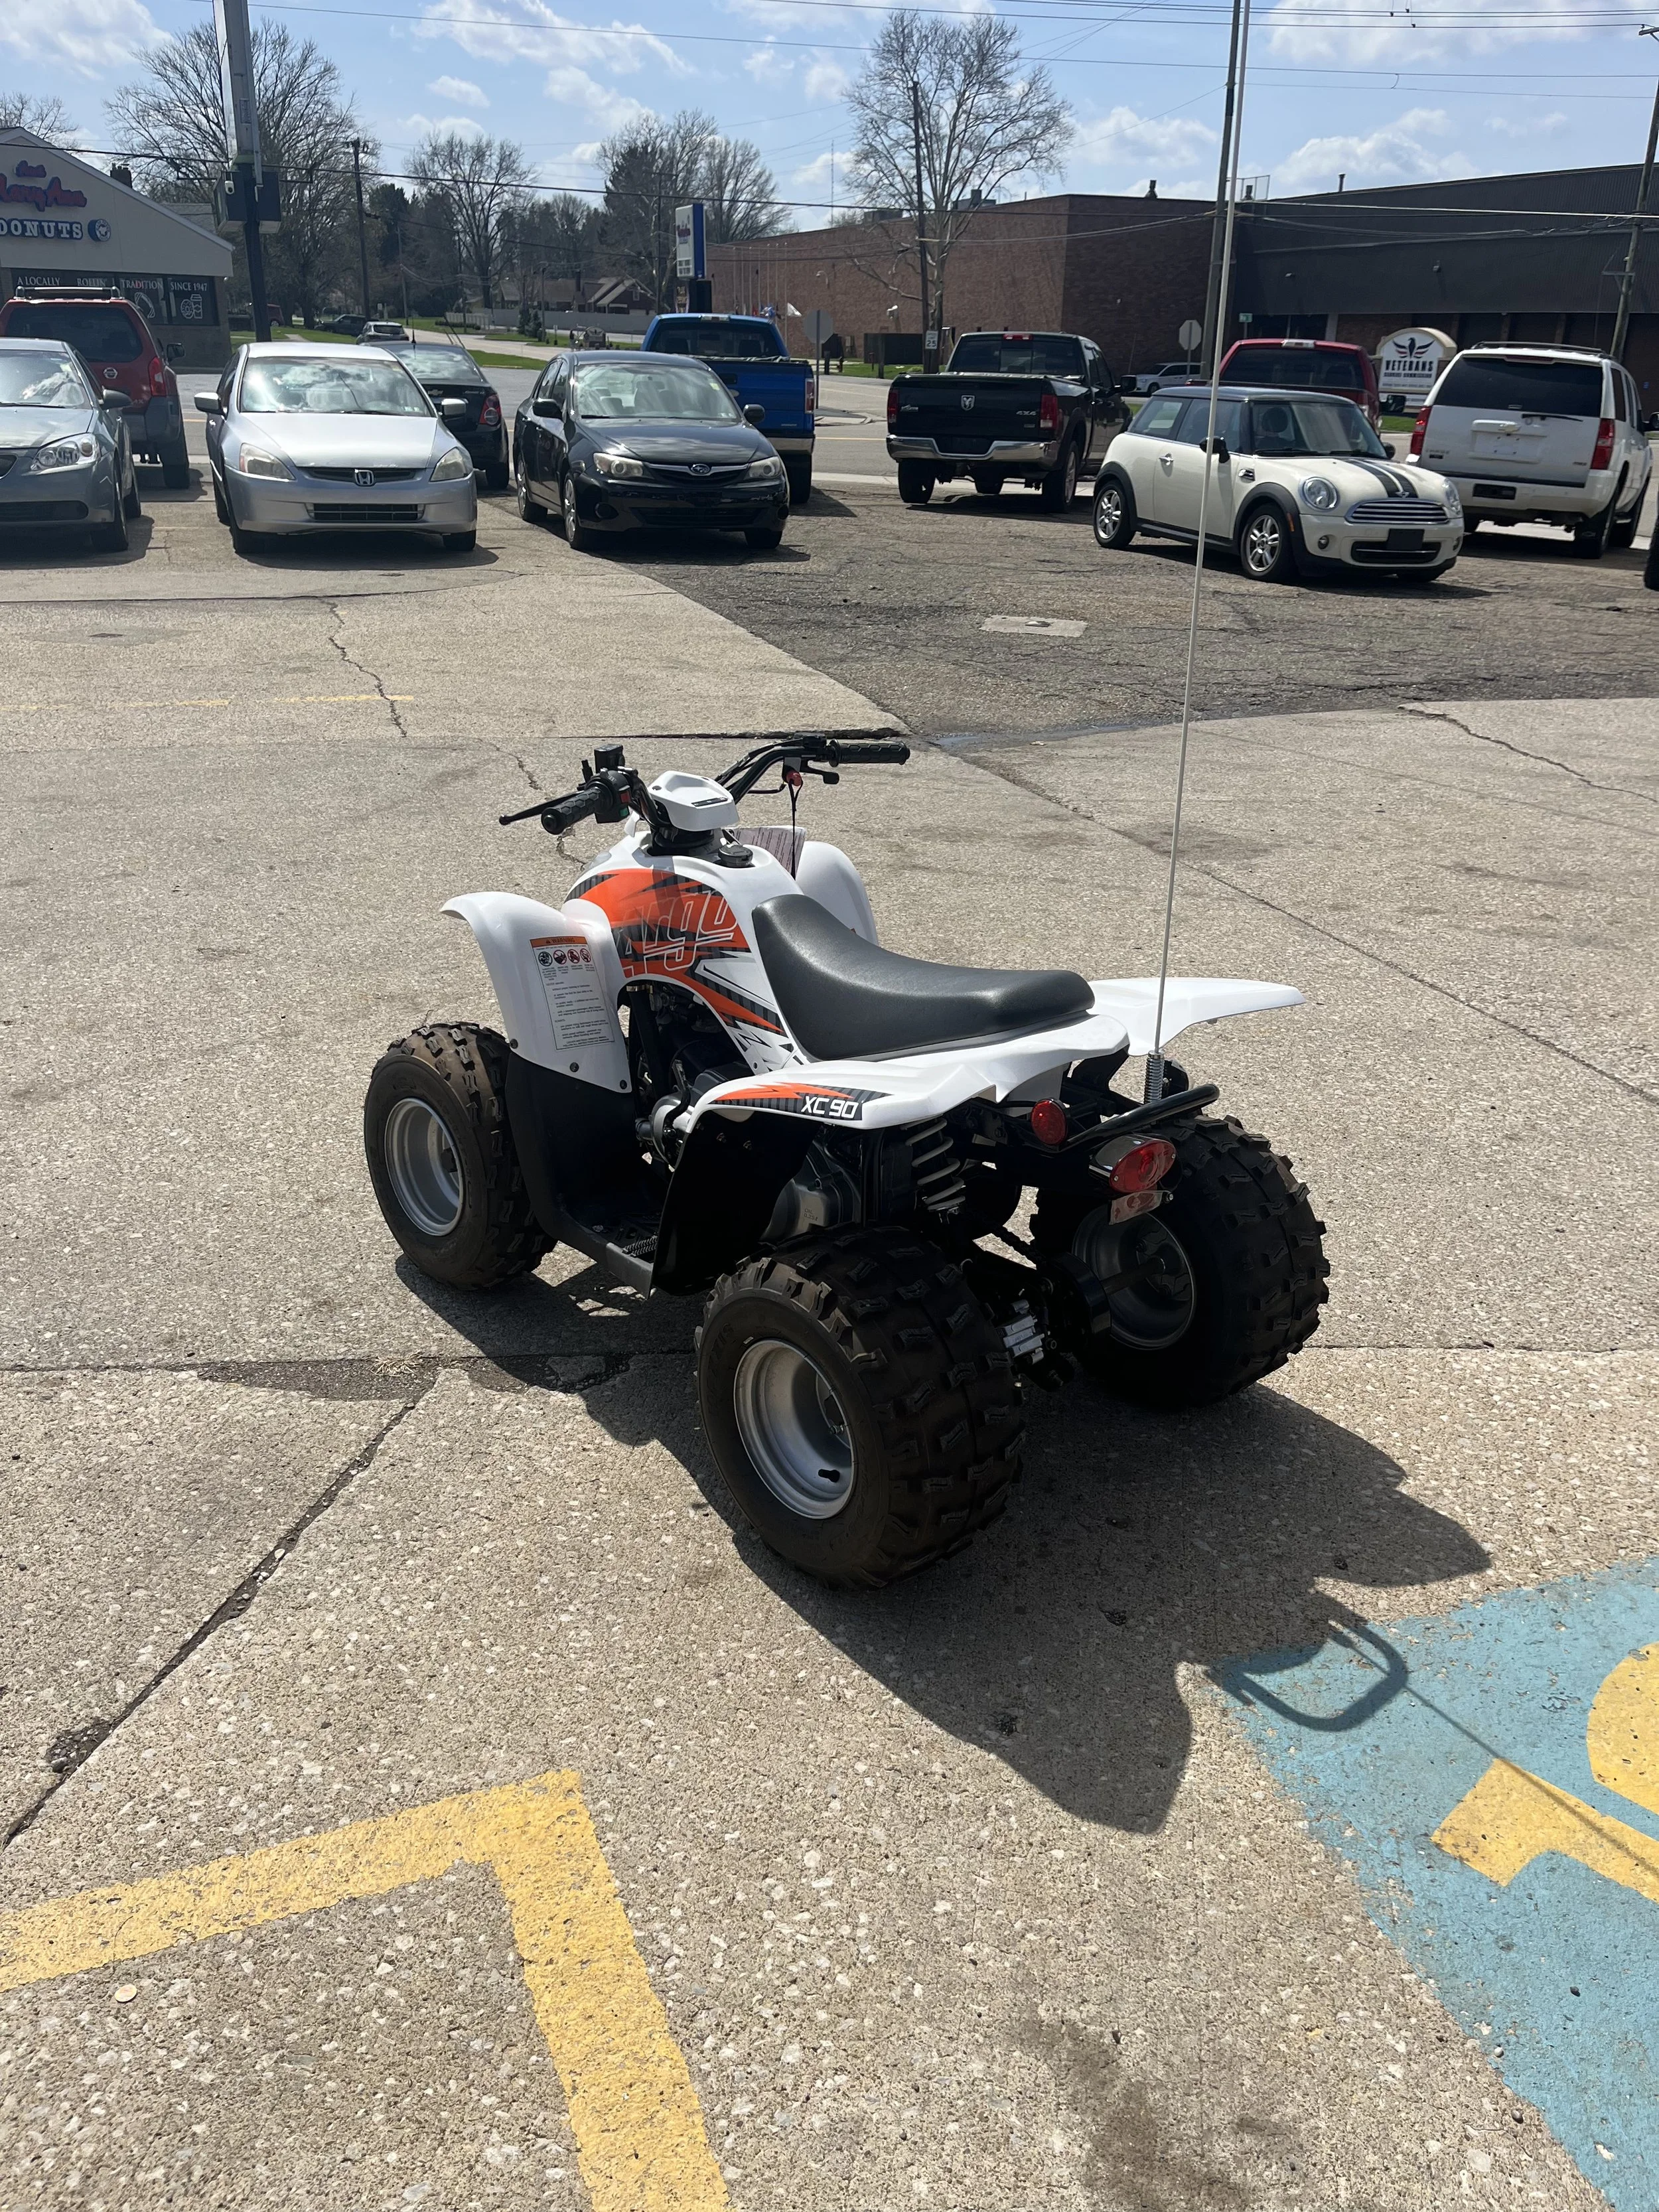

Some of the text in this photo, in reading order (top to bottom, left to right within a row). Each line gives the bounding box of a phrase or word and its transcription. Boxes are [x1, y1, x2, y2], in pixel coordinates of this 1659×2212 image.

[25, 276, 60, 286] LOCALLY
[121, 279, 163, 290] TRADITION
[171, 281, 192, 291] SINCE
[193, 282, 208, 291] 1947
[1385, 360, 1433, 372] VETERANS
[800, 1096, 859, 1119] XC 90
